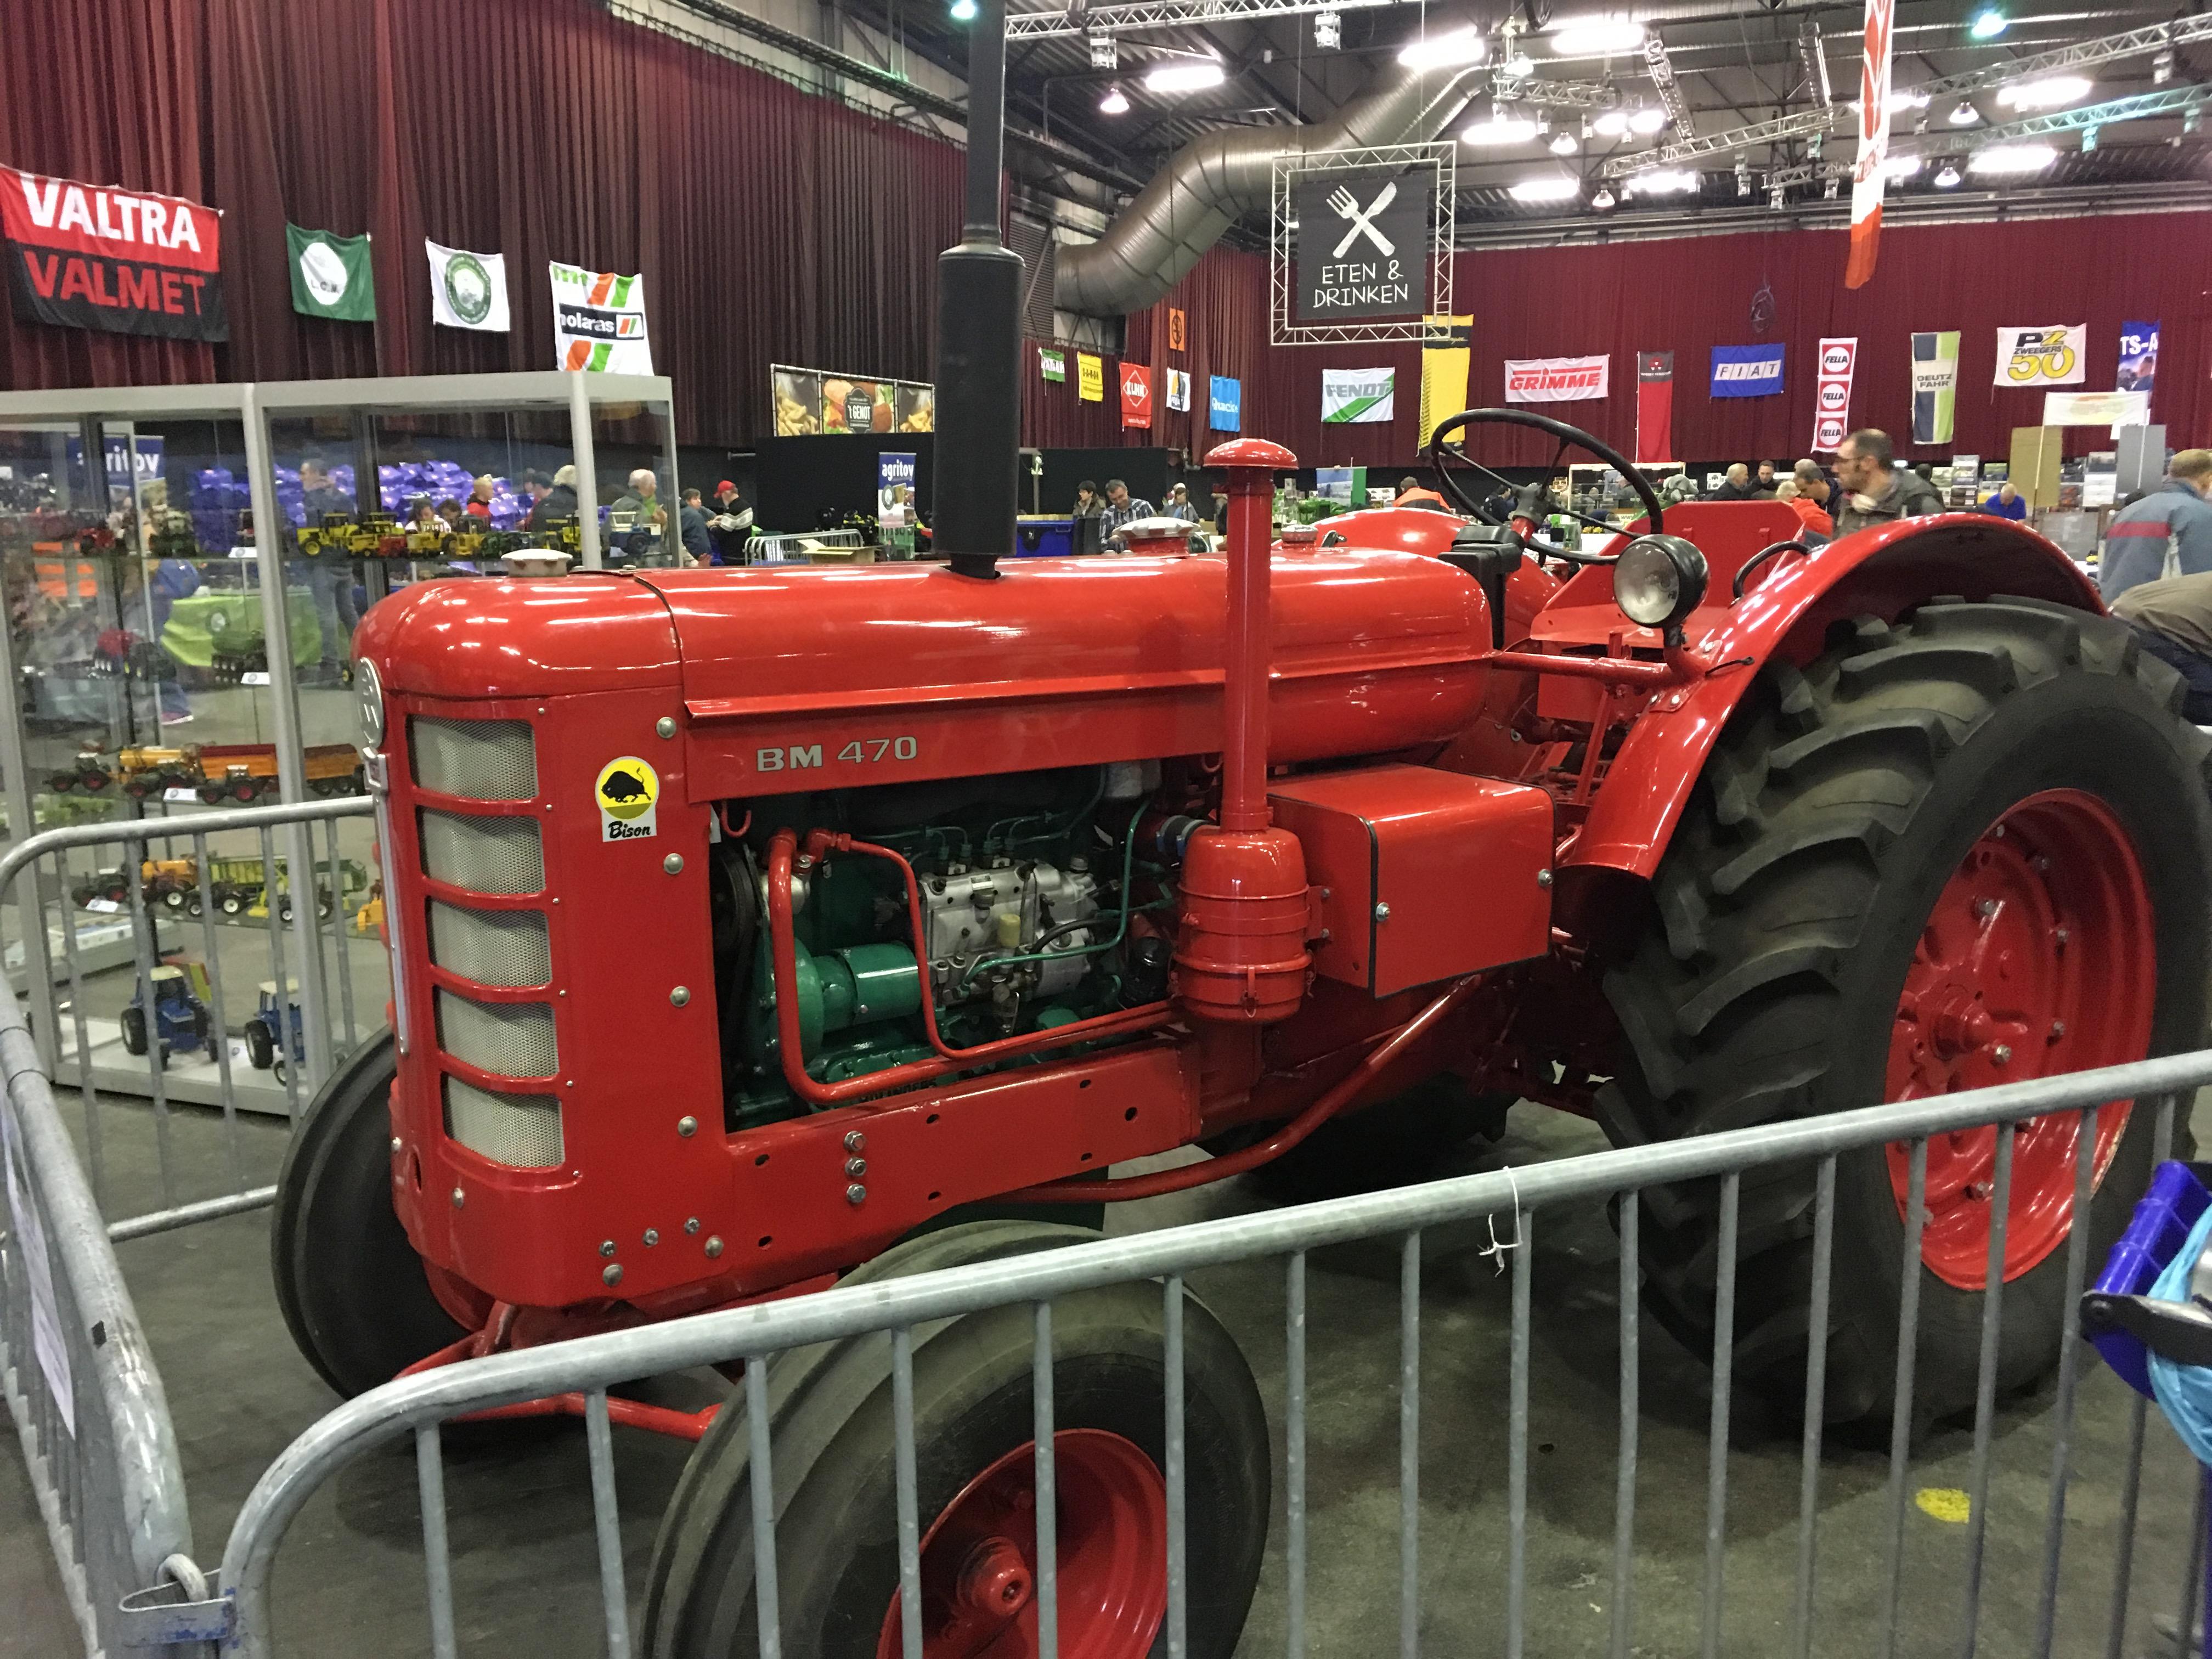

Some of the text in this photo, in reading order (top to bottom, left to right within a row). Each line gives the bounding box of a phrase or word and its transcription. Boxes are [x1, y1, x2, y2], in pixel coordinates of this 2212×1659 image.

[20, 173, 201, 253] VALTRA
[24, 250, 205, 315] VALMET
[1322, 259, 1404, 284] ETEN &
[1313, 283, 1408, 308] DRINKEN
[2016, 330, 2067, 347] PZ
[2120, 332, 2158, 355] TS-A
[1825, 356, 1848, 364] FELLA
[2013, 346, 2062, 354] ZWEEGERS
[1719, 363, 1777, 377] FIAT
[2008, 346, 2075, 380] 50
[1325, 382, 1391, 397] FENDT
[1509, 368, 1600, 390] GRIMME
[1823, 392, 1844, 400] FELLA
[853, 405, 871, 420] GENOT
[882, 459, 914, 481] agritoy
[757, 736, 917, 772] BM 470
[608, 821, 651, 839] Bison
